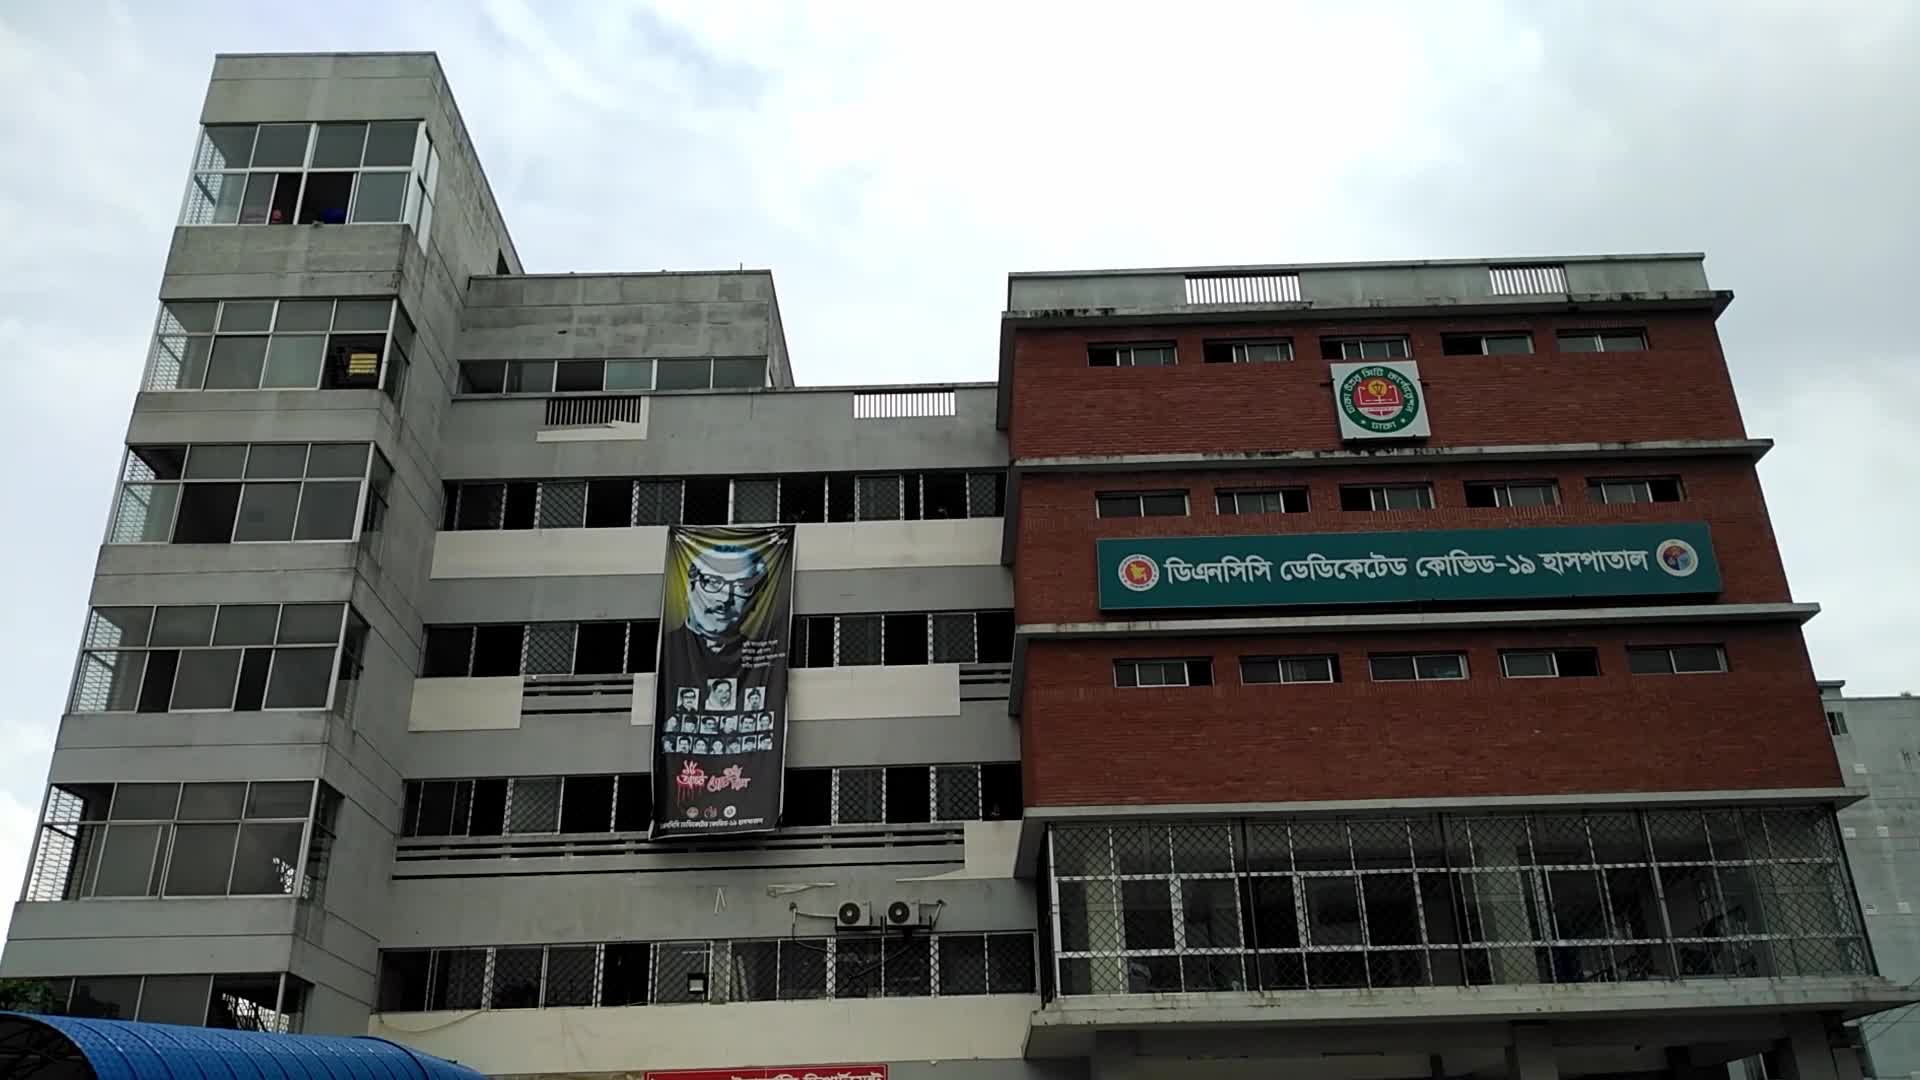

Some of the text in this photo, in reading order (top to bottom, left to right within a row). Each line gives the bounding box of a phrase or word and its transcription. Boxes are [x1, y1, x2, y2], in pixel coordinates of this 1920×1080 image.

[1164, 555, 1273, 584] ডিএনসিসি
[1280, 552, 1408, 581] ডেডিকেটেড
[1416, 549, 1536, 577] কোভিড-১৯
[1537, 550, 1649, 576] হাসপাতাল
